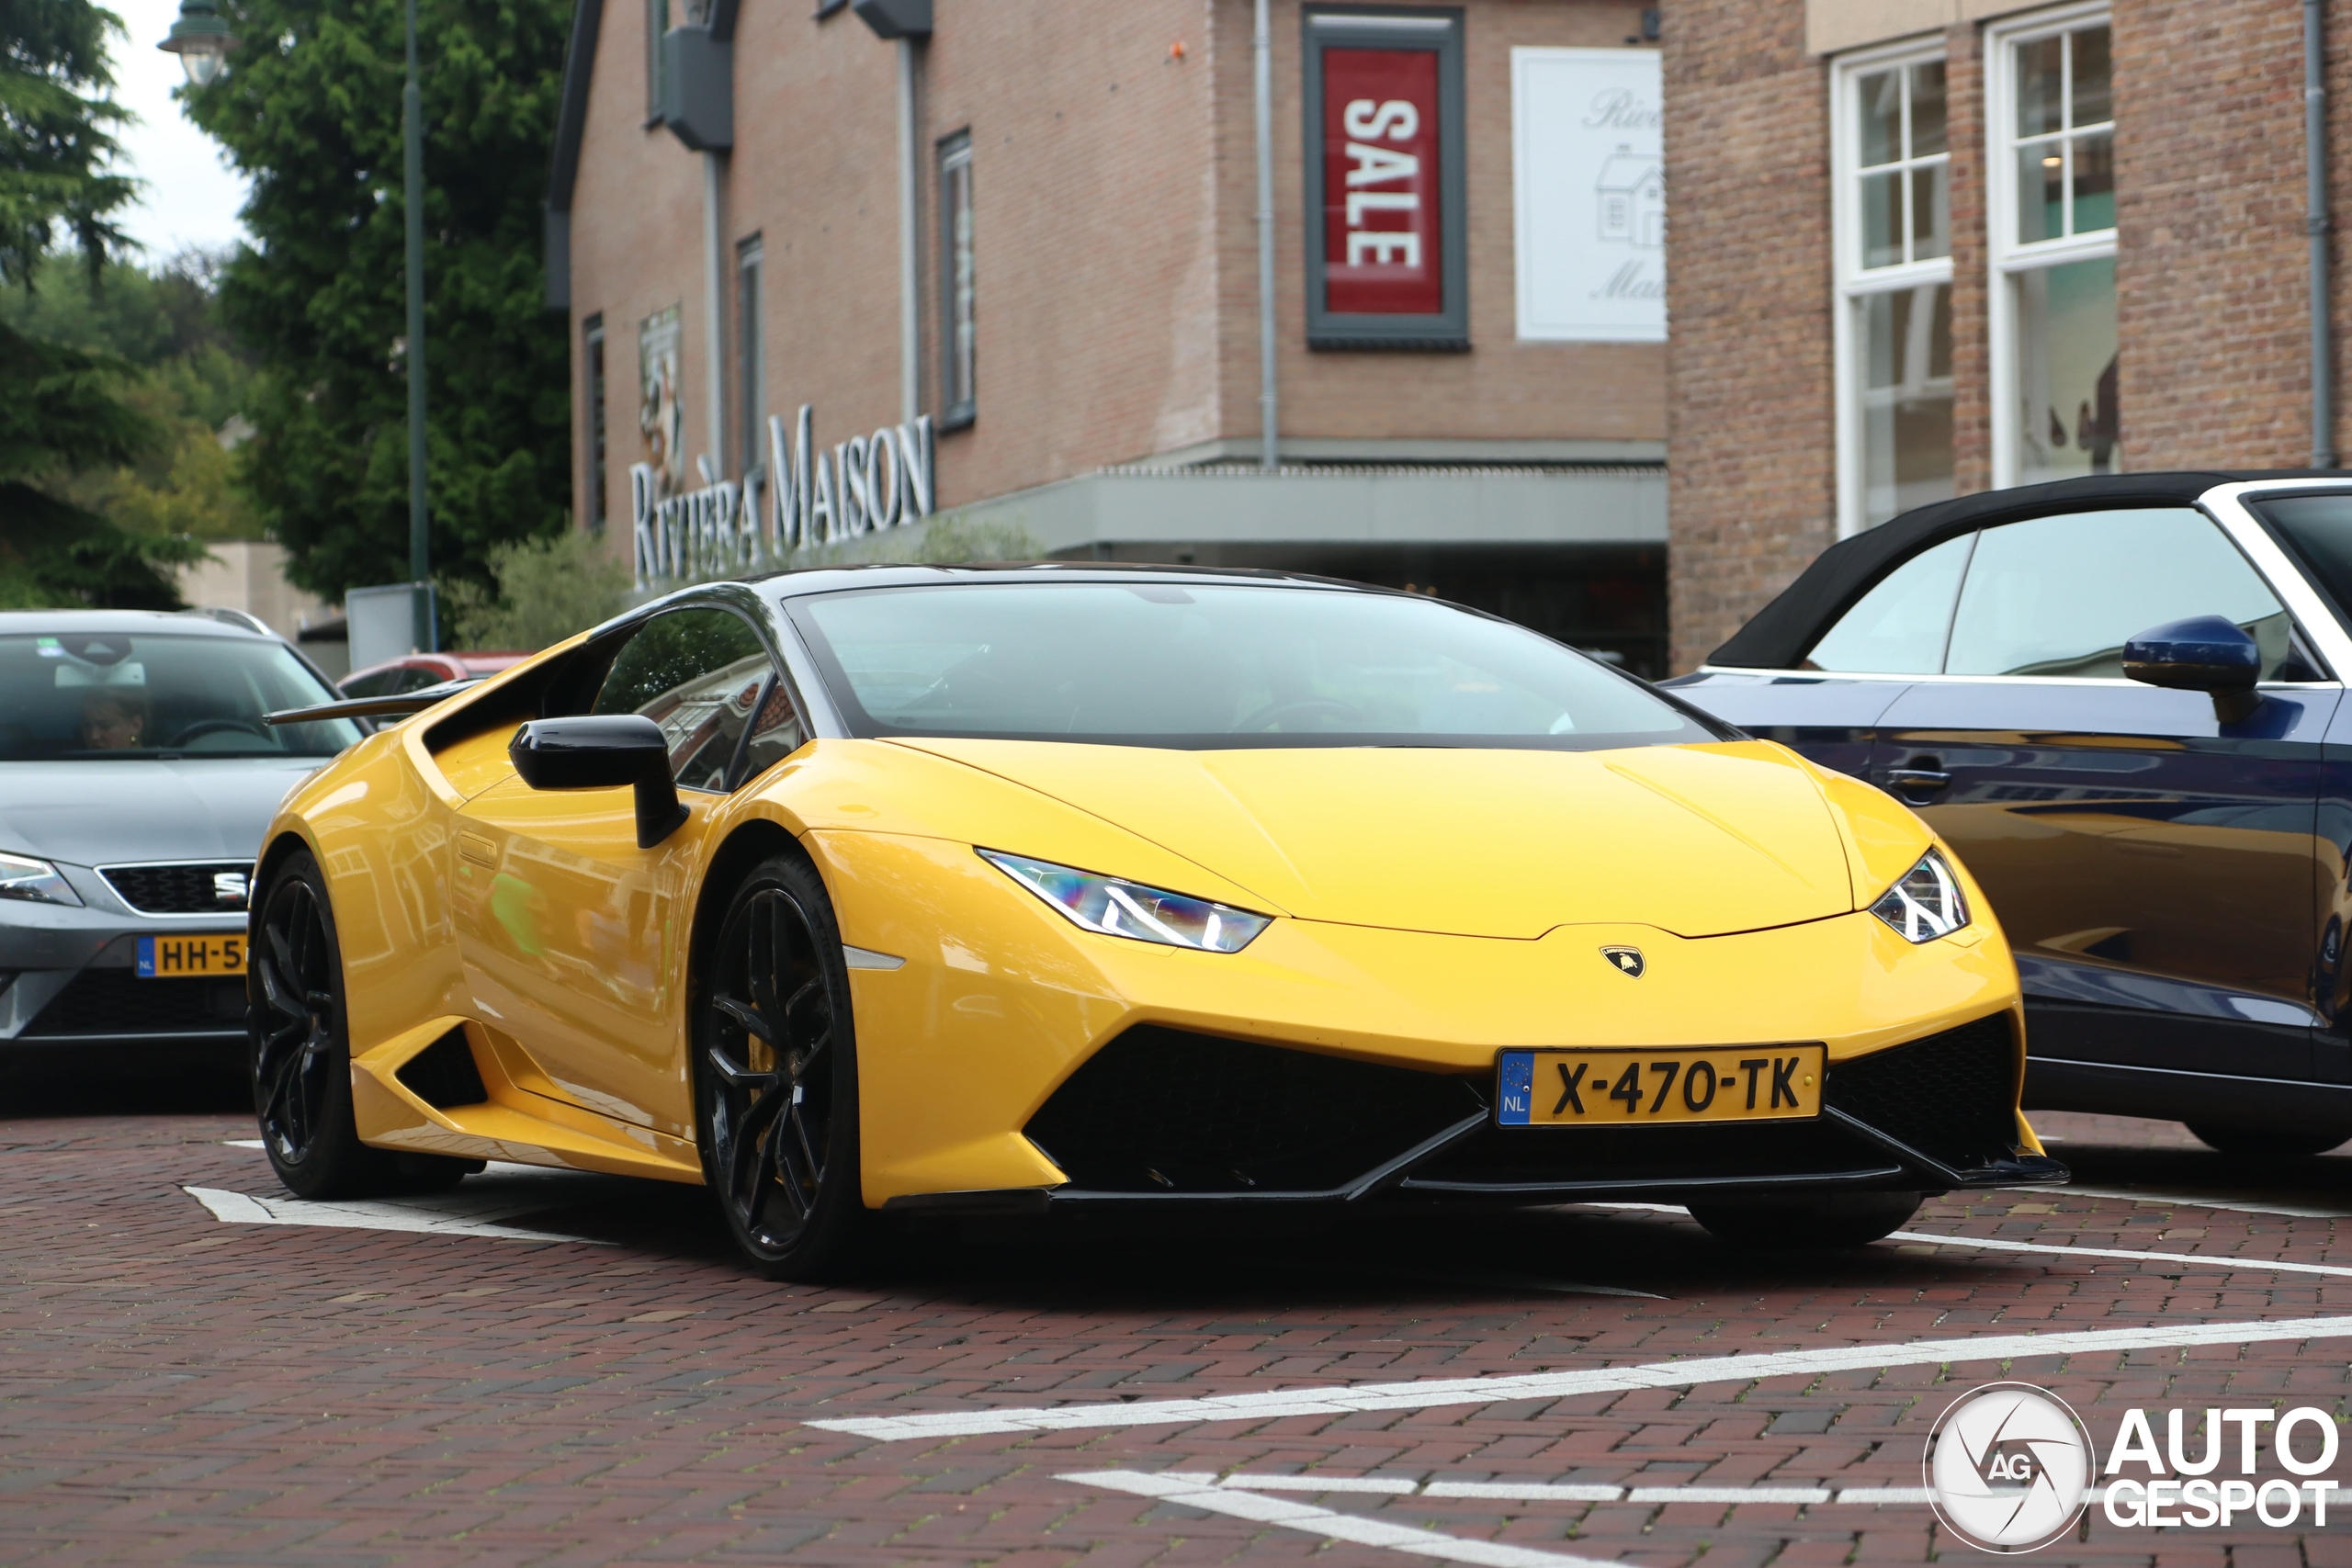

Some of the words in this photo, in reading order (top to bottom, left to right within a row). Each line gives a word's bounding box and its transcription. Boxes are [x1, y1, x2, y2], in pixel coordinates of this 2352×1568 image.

[1343, 99, 1420, 267] SALE
[769, 403, 934, 556] MAISON
[139, 960, 153, 970] NL
[163, 940, 242, 970] HH-5
[1504, 1096, 1525, 1111] NL
[1553, 1056, 1799, 1114] X-470-TK
